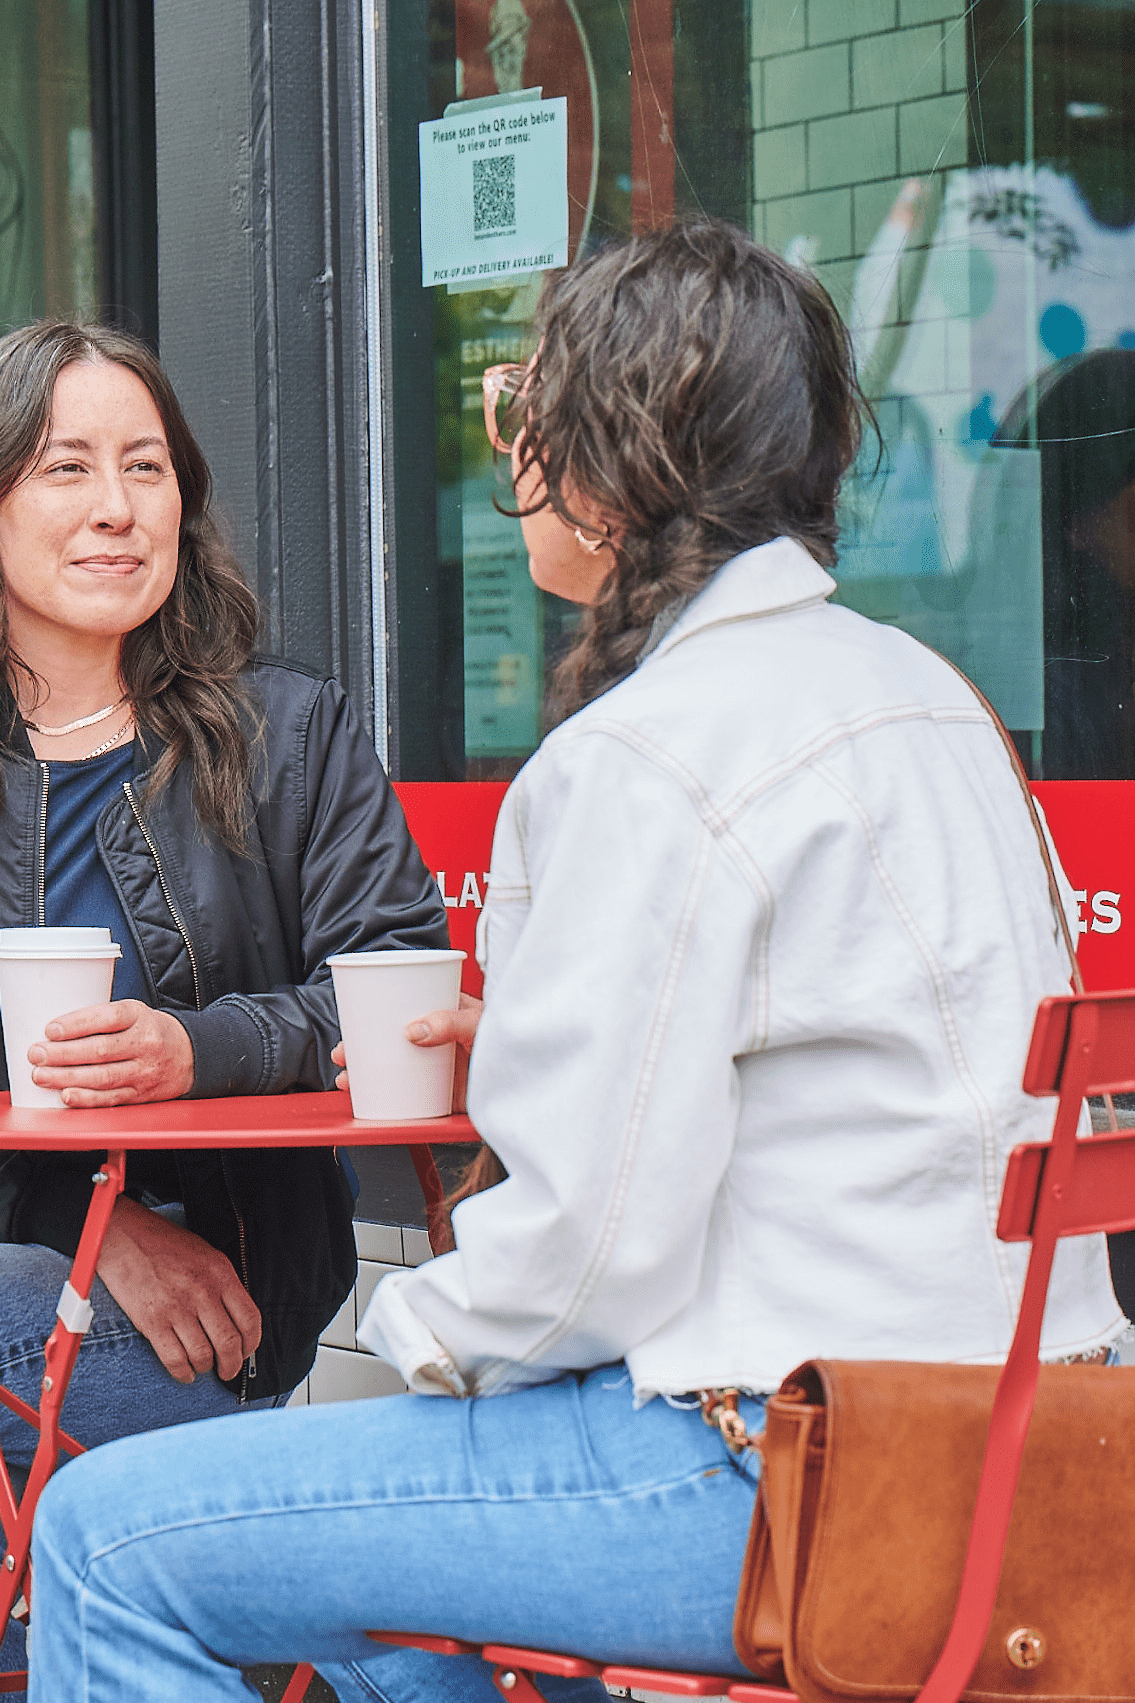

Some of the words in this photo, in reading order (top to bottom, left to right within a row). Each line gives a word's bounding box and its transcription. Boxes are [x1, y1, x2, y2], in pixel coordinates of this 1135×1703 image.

[433, 129, 456, 143] Please
[459, 126, 475, 138] scan
[478, 122, 491, 134] the
[493, 118, 506, 132] QR
[508, 115, 528, 129] code
[530, 112, 555, 125] below
[457, 143, 465, 154] to
[468, 139, 485, 151] view
[488, 136, 502, 148] our
[505, 132, 531, 145] menu:
[433, 267, 460, 281] PICK-UP
[462, 265, 476, 276] AND
[478, 260, 510, 273] DELIVERY
[512, 254, 554, 268] AVAILABLE!
